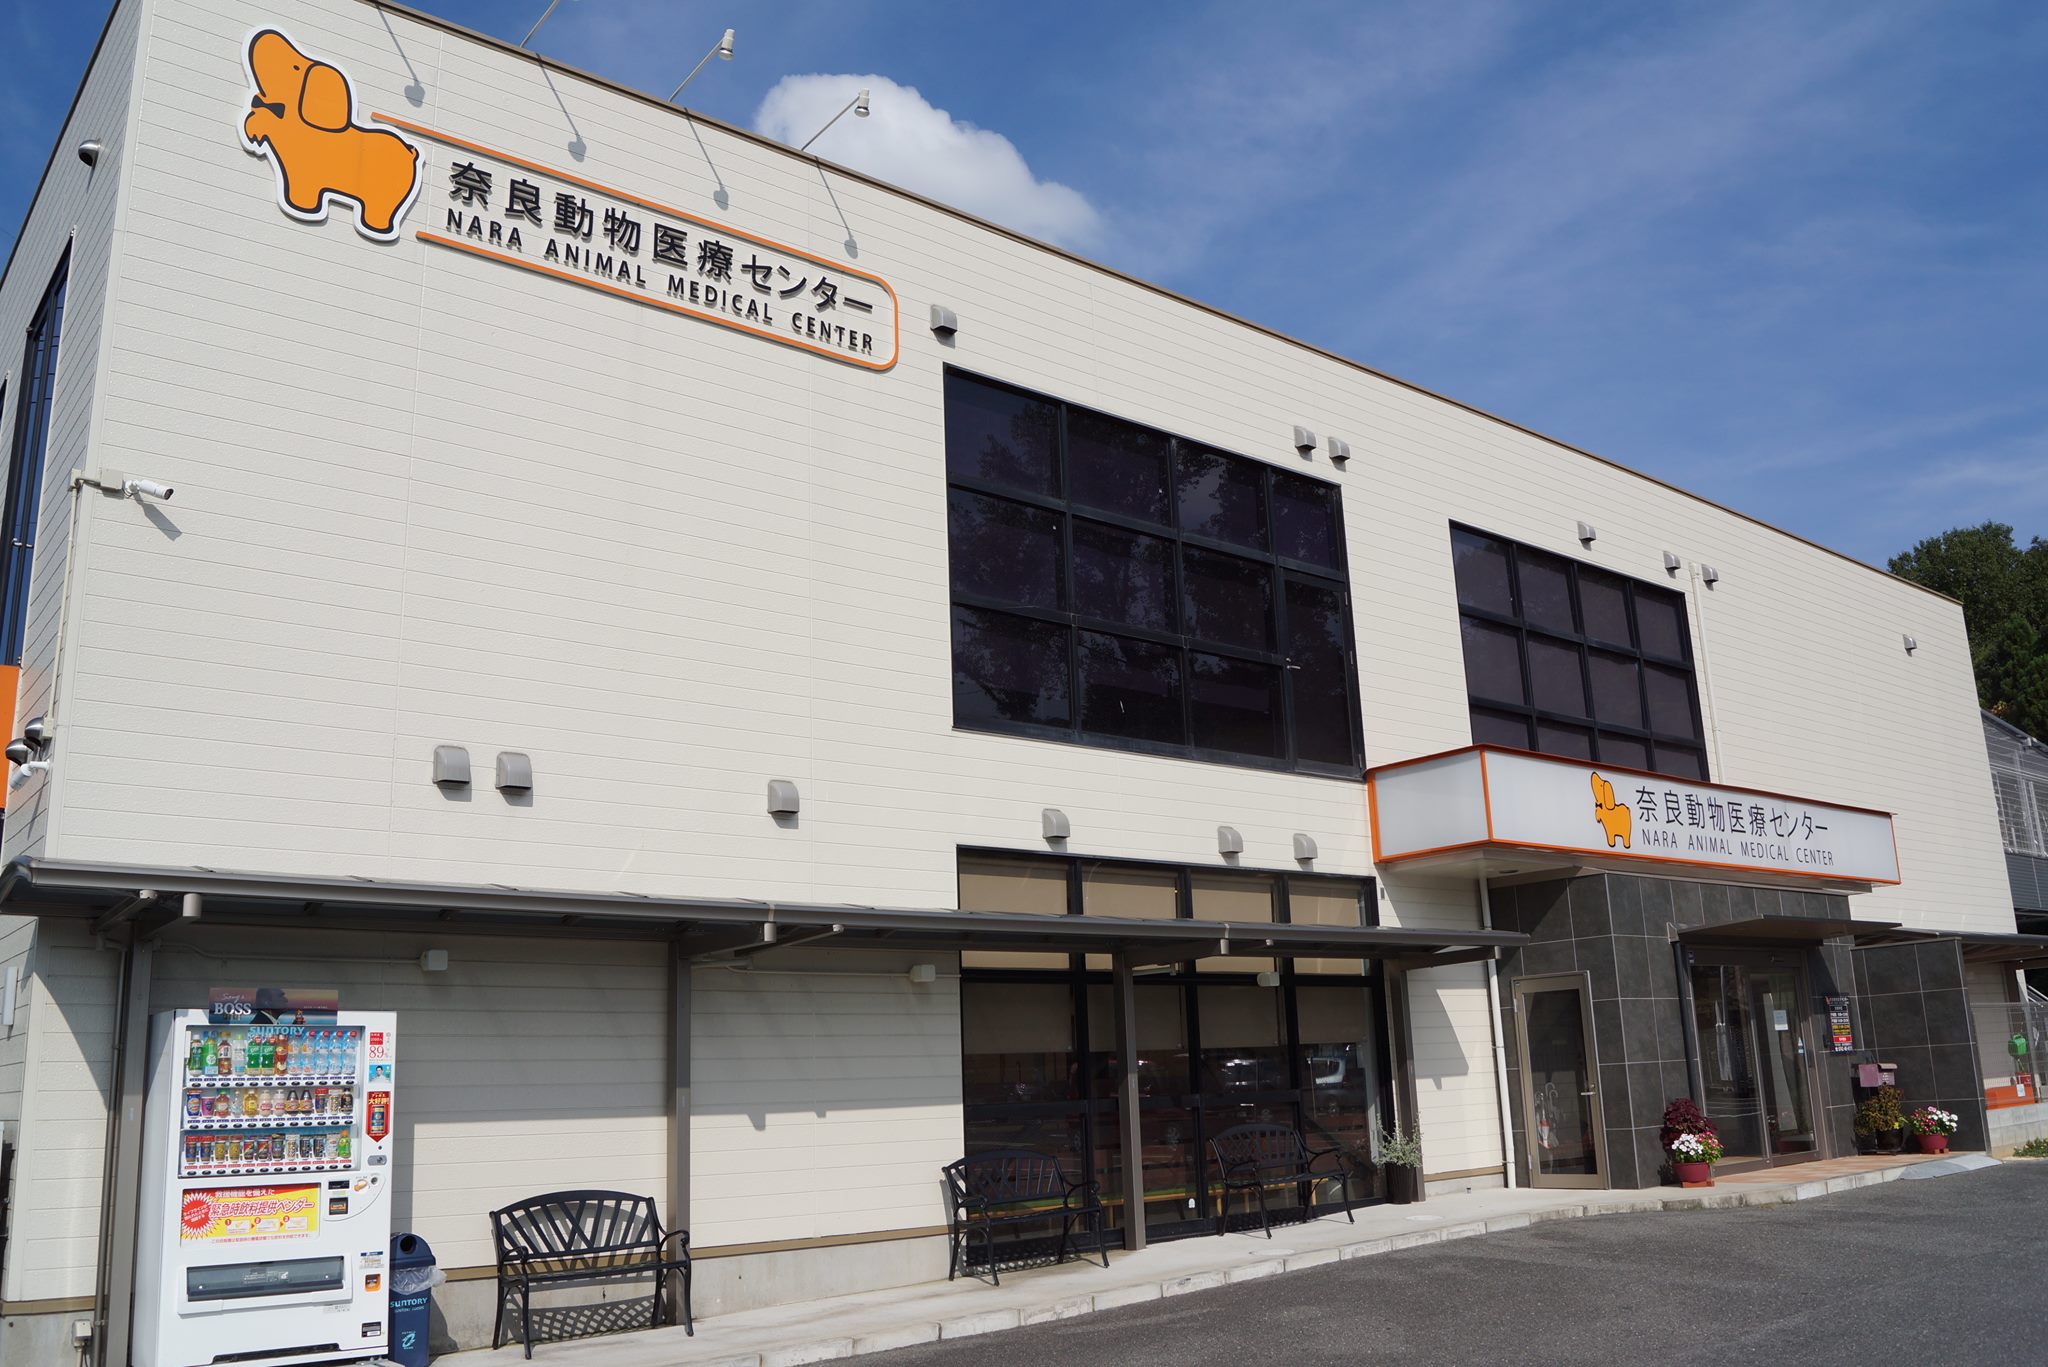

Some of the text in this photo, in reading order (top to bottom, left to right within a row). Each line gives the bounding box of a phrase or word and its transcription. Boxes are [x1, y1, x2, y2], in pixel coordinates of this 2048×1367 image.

[448, 161, 874, 313] 奈良動物医療センター
[446, 208, 874, 353] NARA ANIMAL MEDICAL CENTER
[1635, 785, 1829, 841] 奈良動物医療センター
[1641, 828, 1834, 866] NARA ANIMAL MEDICAL CENTER
[214, 1003, 252, 1015] BOSS
[249, 1026, 305, 1036] SUNTORY
[369, 1045, 385, 1059] 89
[389, 1297, 428, 1308] SUNTORY
